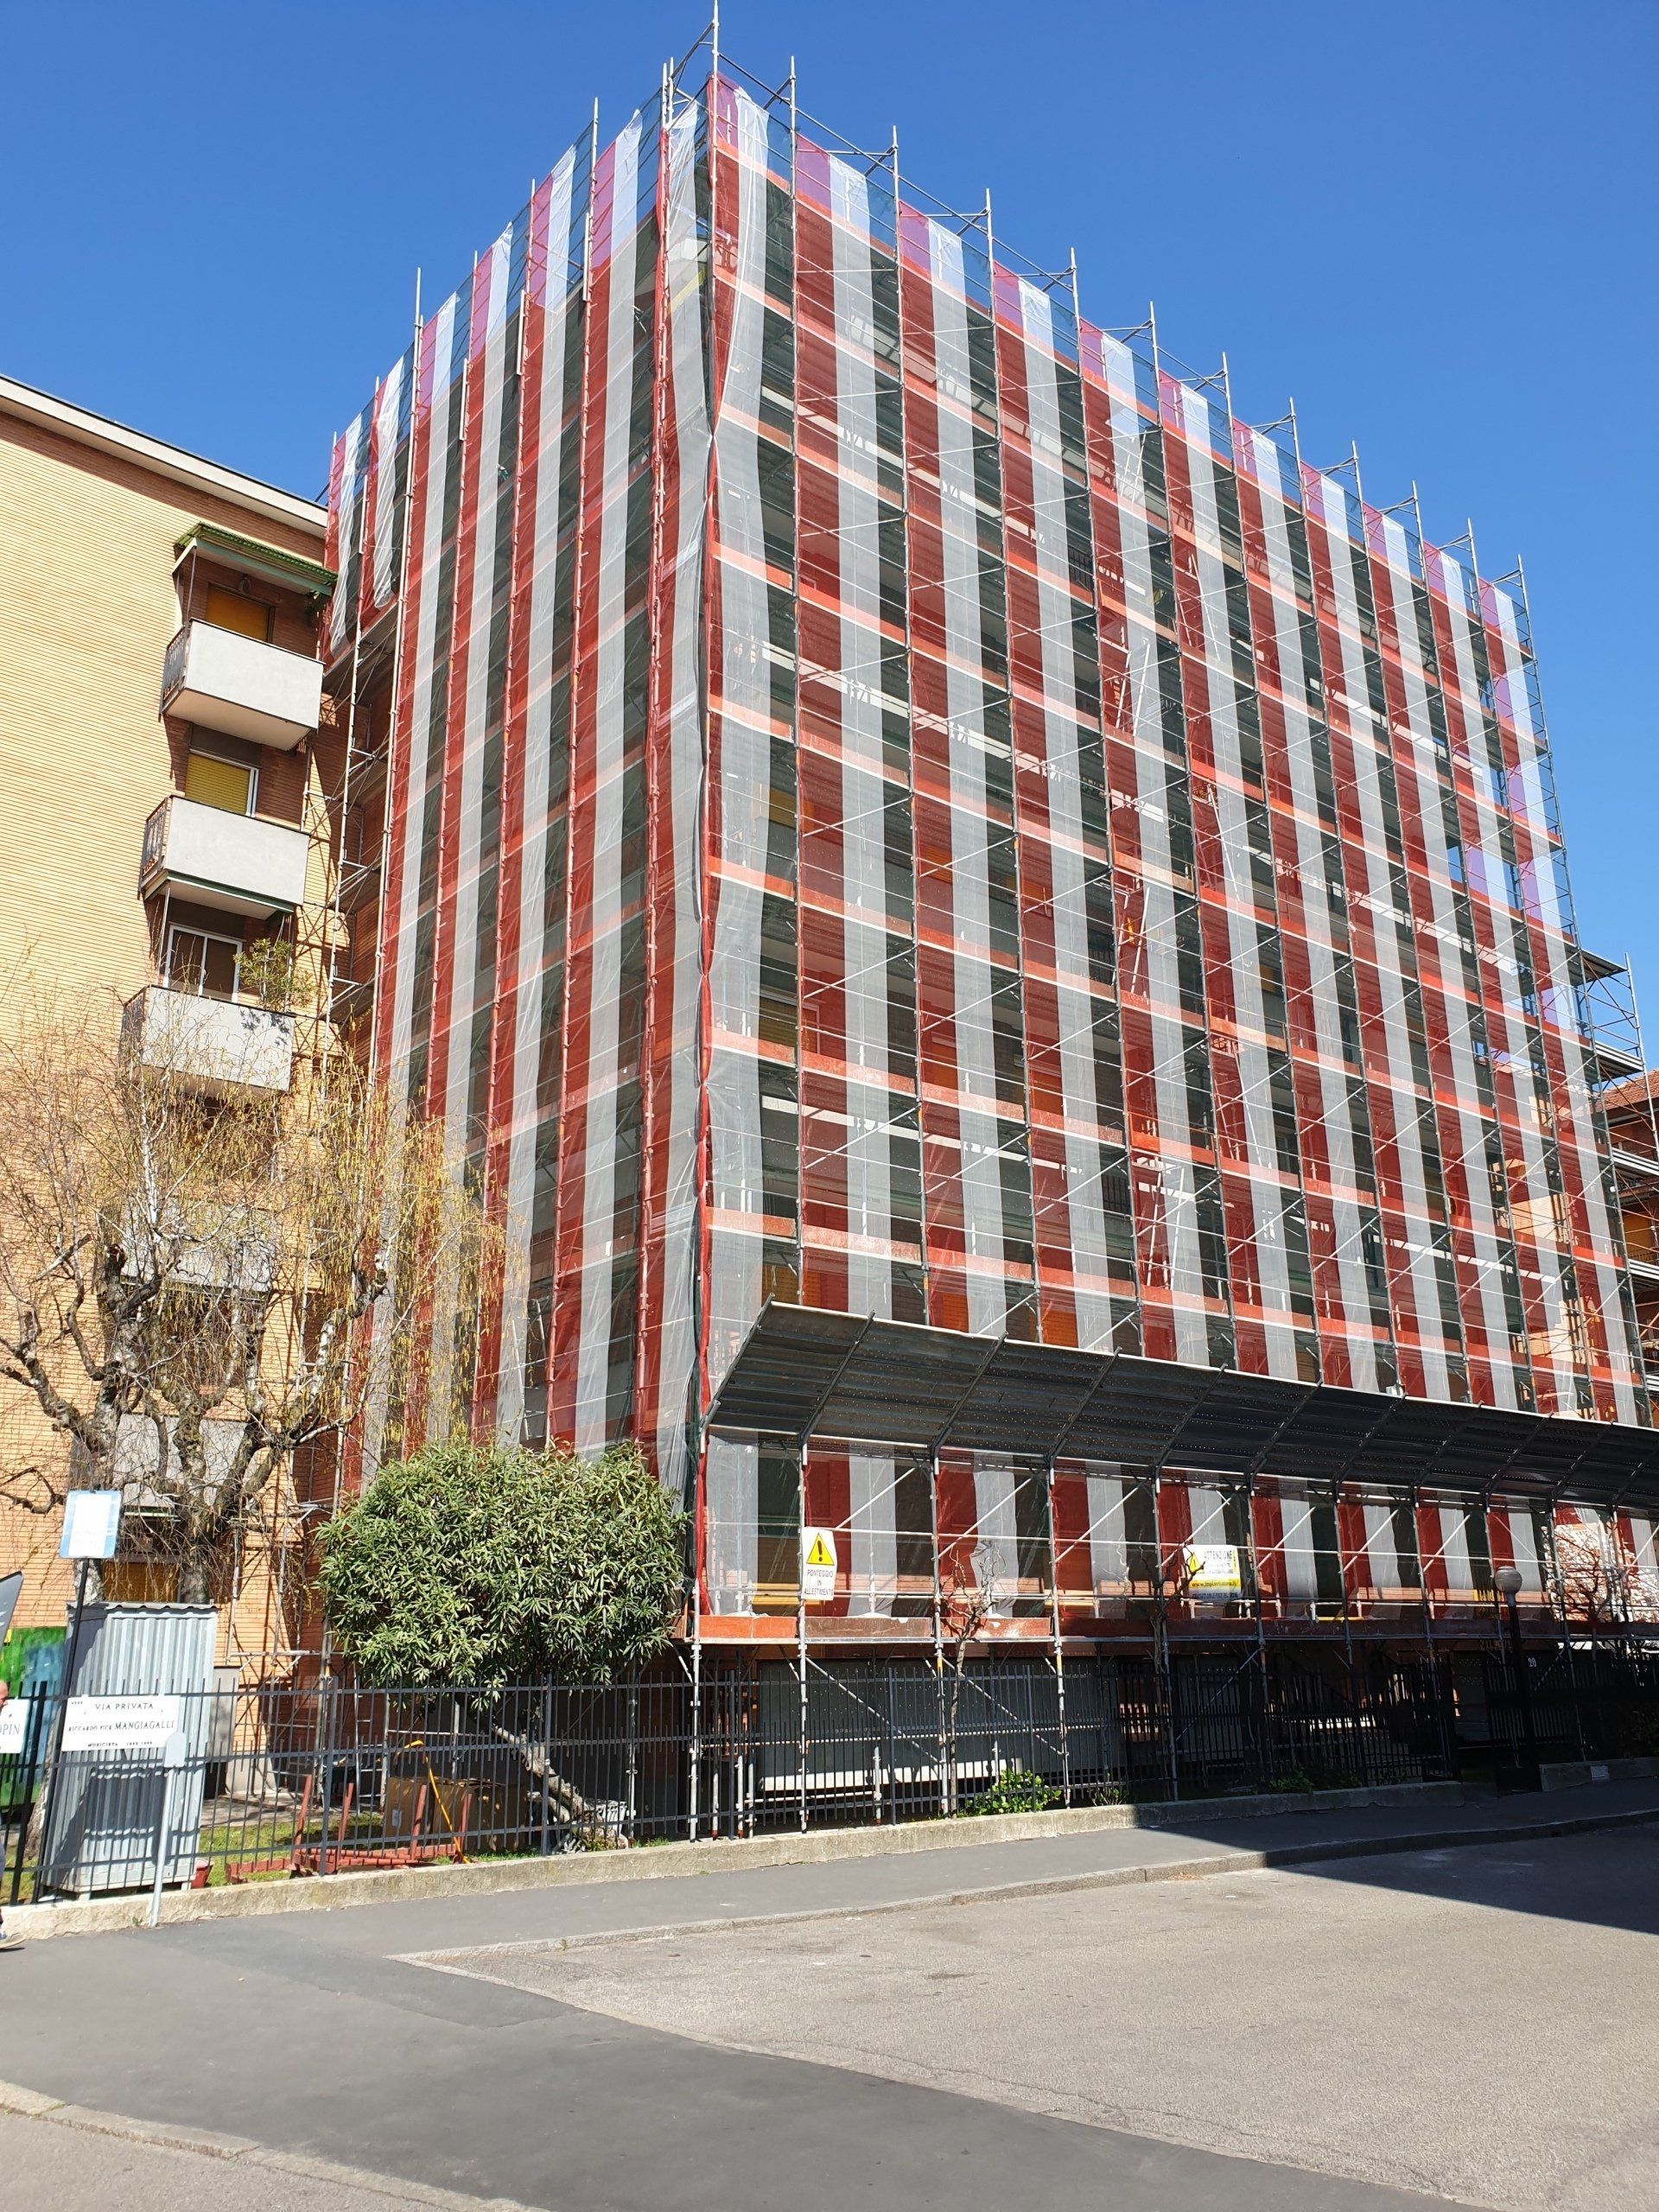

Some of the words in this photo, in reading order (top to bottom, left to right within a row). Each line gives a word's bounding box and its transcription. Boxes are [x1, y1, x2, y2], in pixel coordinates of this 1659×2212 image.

[807, 1569, 833, 1578] PONTEGGIO
[804, 1587, 833, 1596] ALLESTIMENTO
[115, 1720, 175, 1730] MANGIAGALLI
